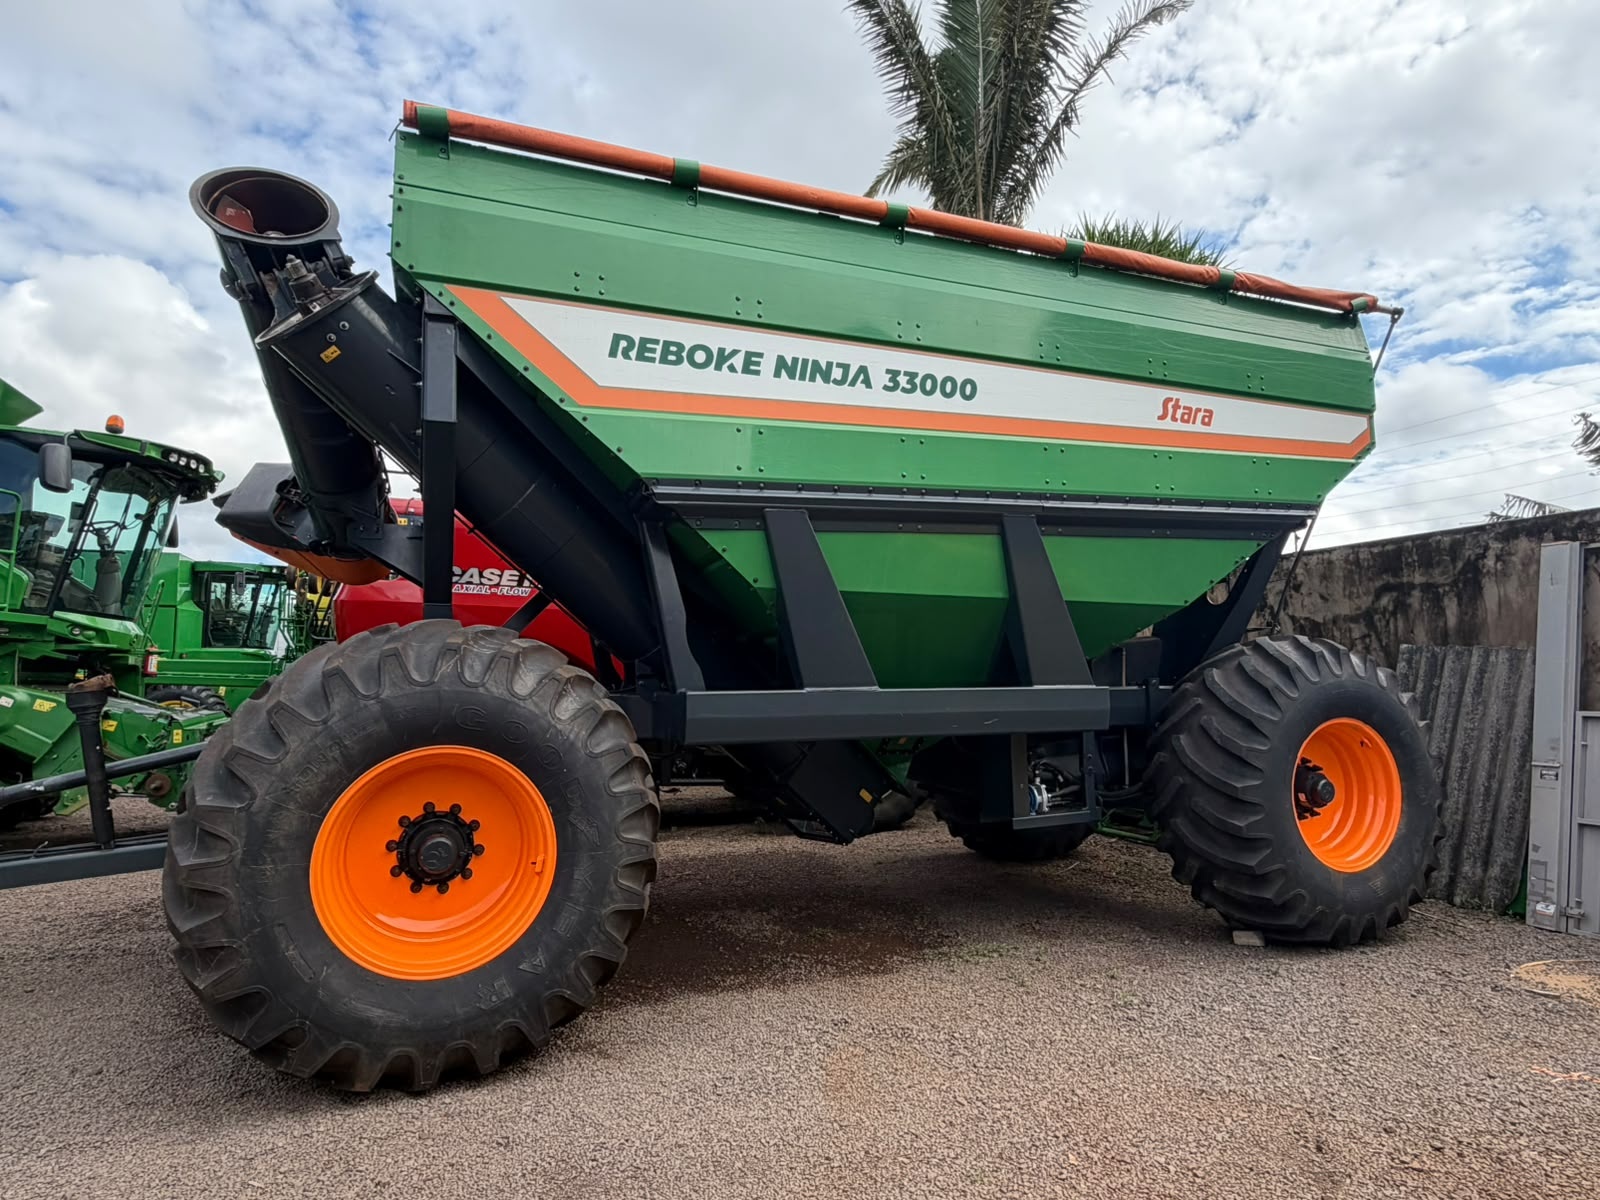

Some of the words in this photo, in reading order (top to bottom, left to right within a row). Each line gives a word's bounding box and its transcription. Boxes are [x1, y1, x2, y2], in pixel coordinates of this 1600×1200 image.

[608, 333, 764, 376] REBOKE
[773, 354, 873, 390] NINJA
[882, 368, 978, 401] 33000
[1157, 397, 1214, 427] Stara
